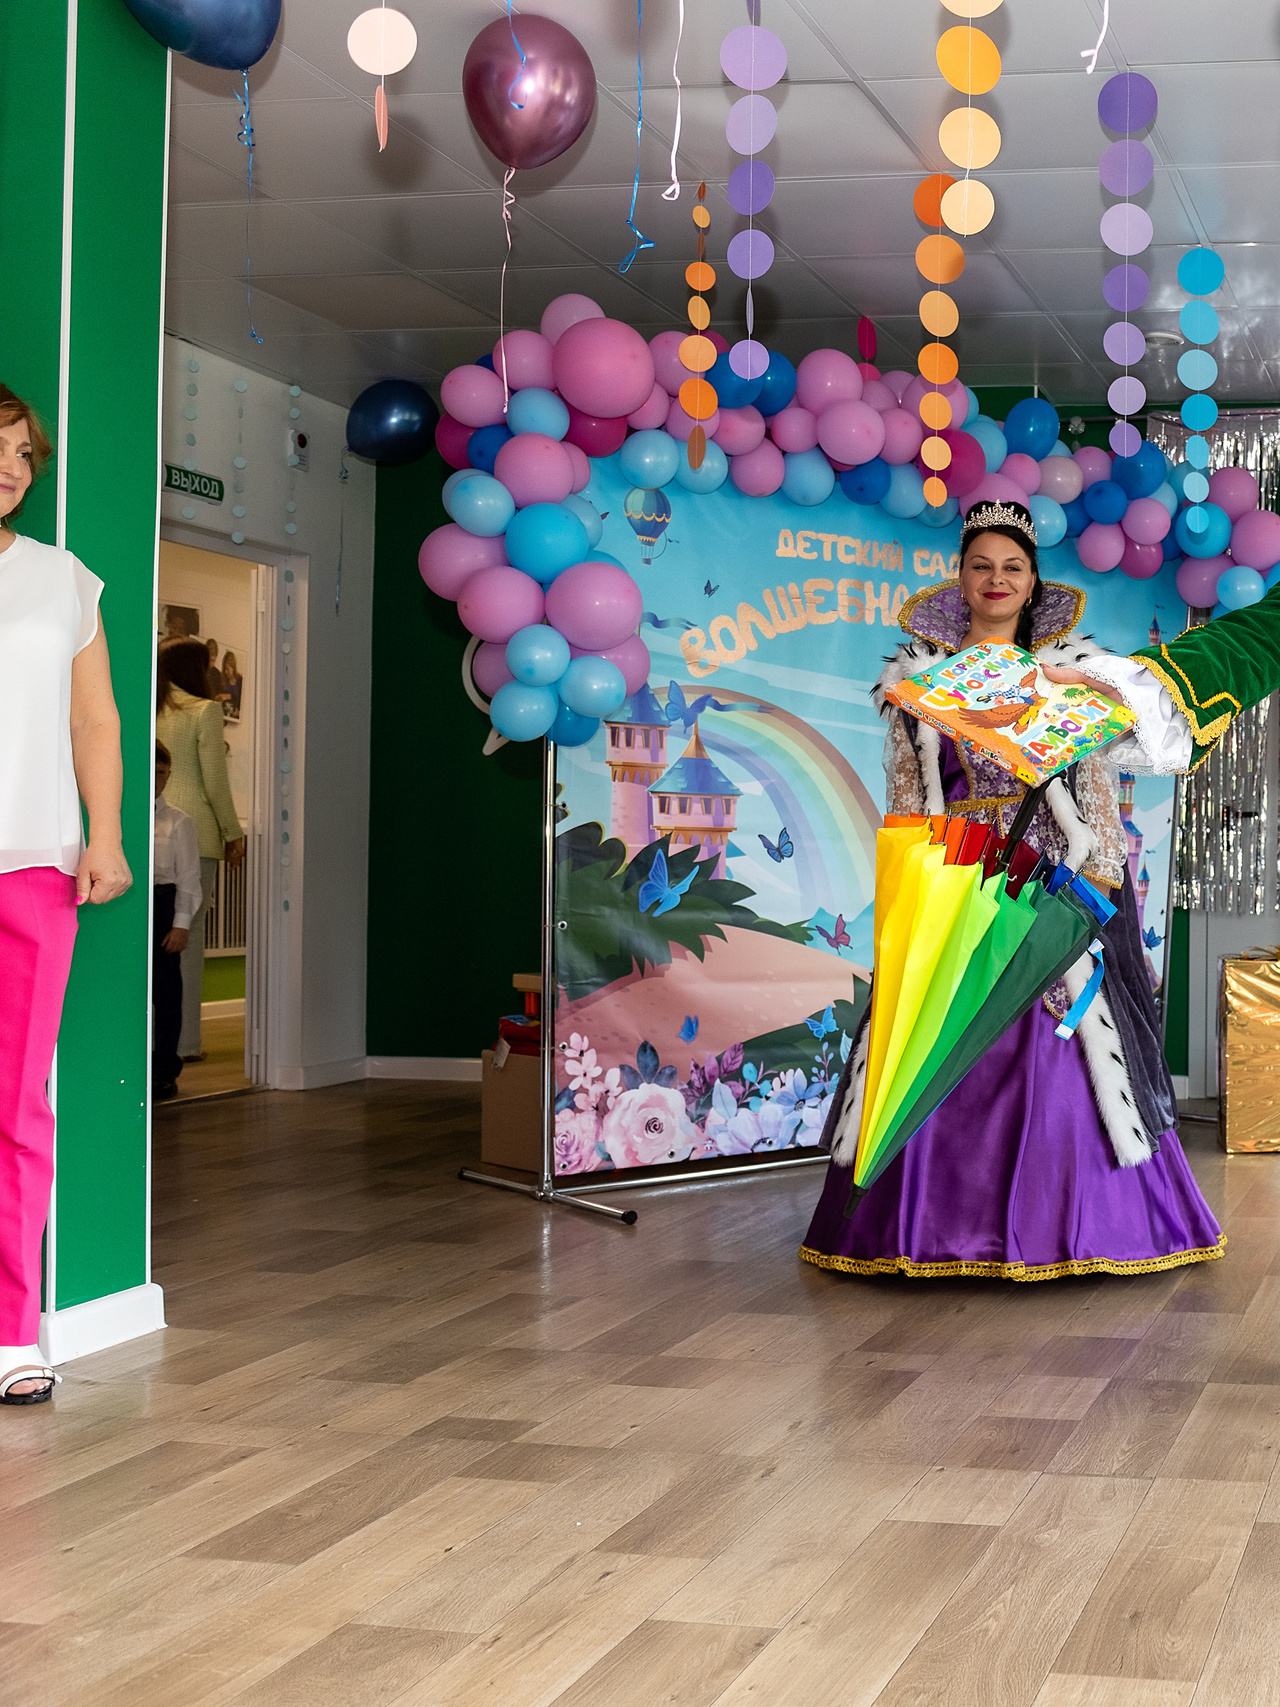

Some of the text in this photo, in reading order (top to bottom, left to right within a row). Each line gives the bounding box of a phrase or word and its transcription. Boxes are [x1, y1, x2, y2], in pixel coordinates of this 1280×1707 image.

[171, 468, 219, 498] ВЫХОД
[776, 529, 903, 572] ДЕТСКИЙ
[680, 578, 927, 678] ВОЛШЕБНА
[923, 648, 1021, 709] ЧУКОВСКИЙ
[940, 650, 990, 680] КОРНЕЙ
[1028, 699, 1109, 758] АЙБОЛИТ
[980, 747, 1012, 770] АЙБО
